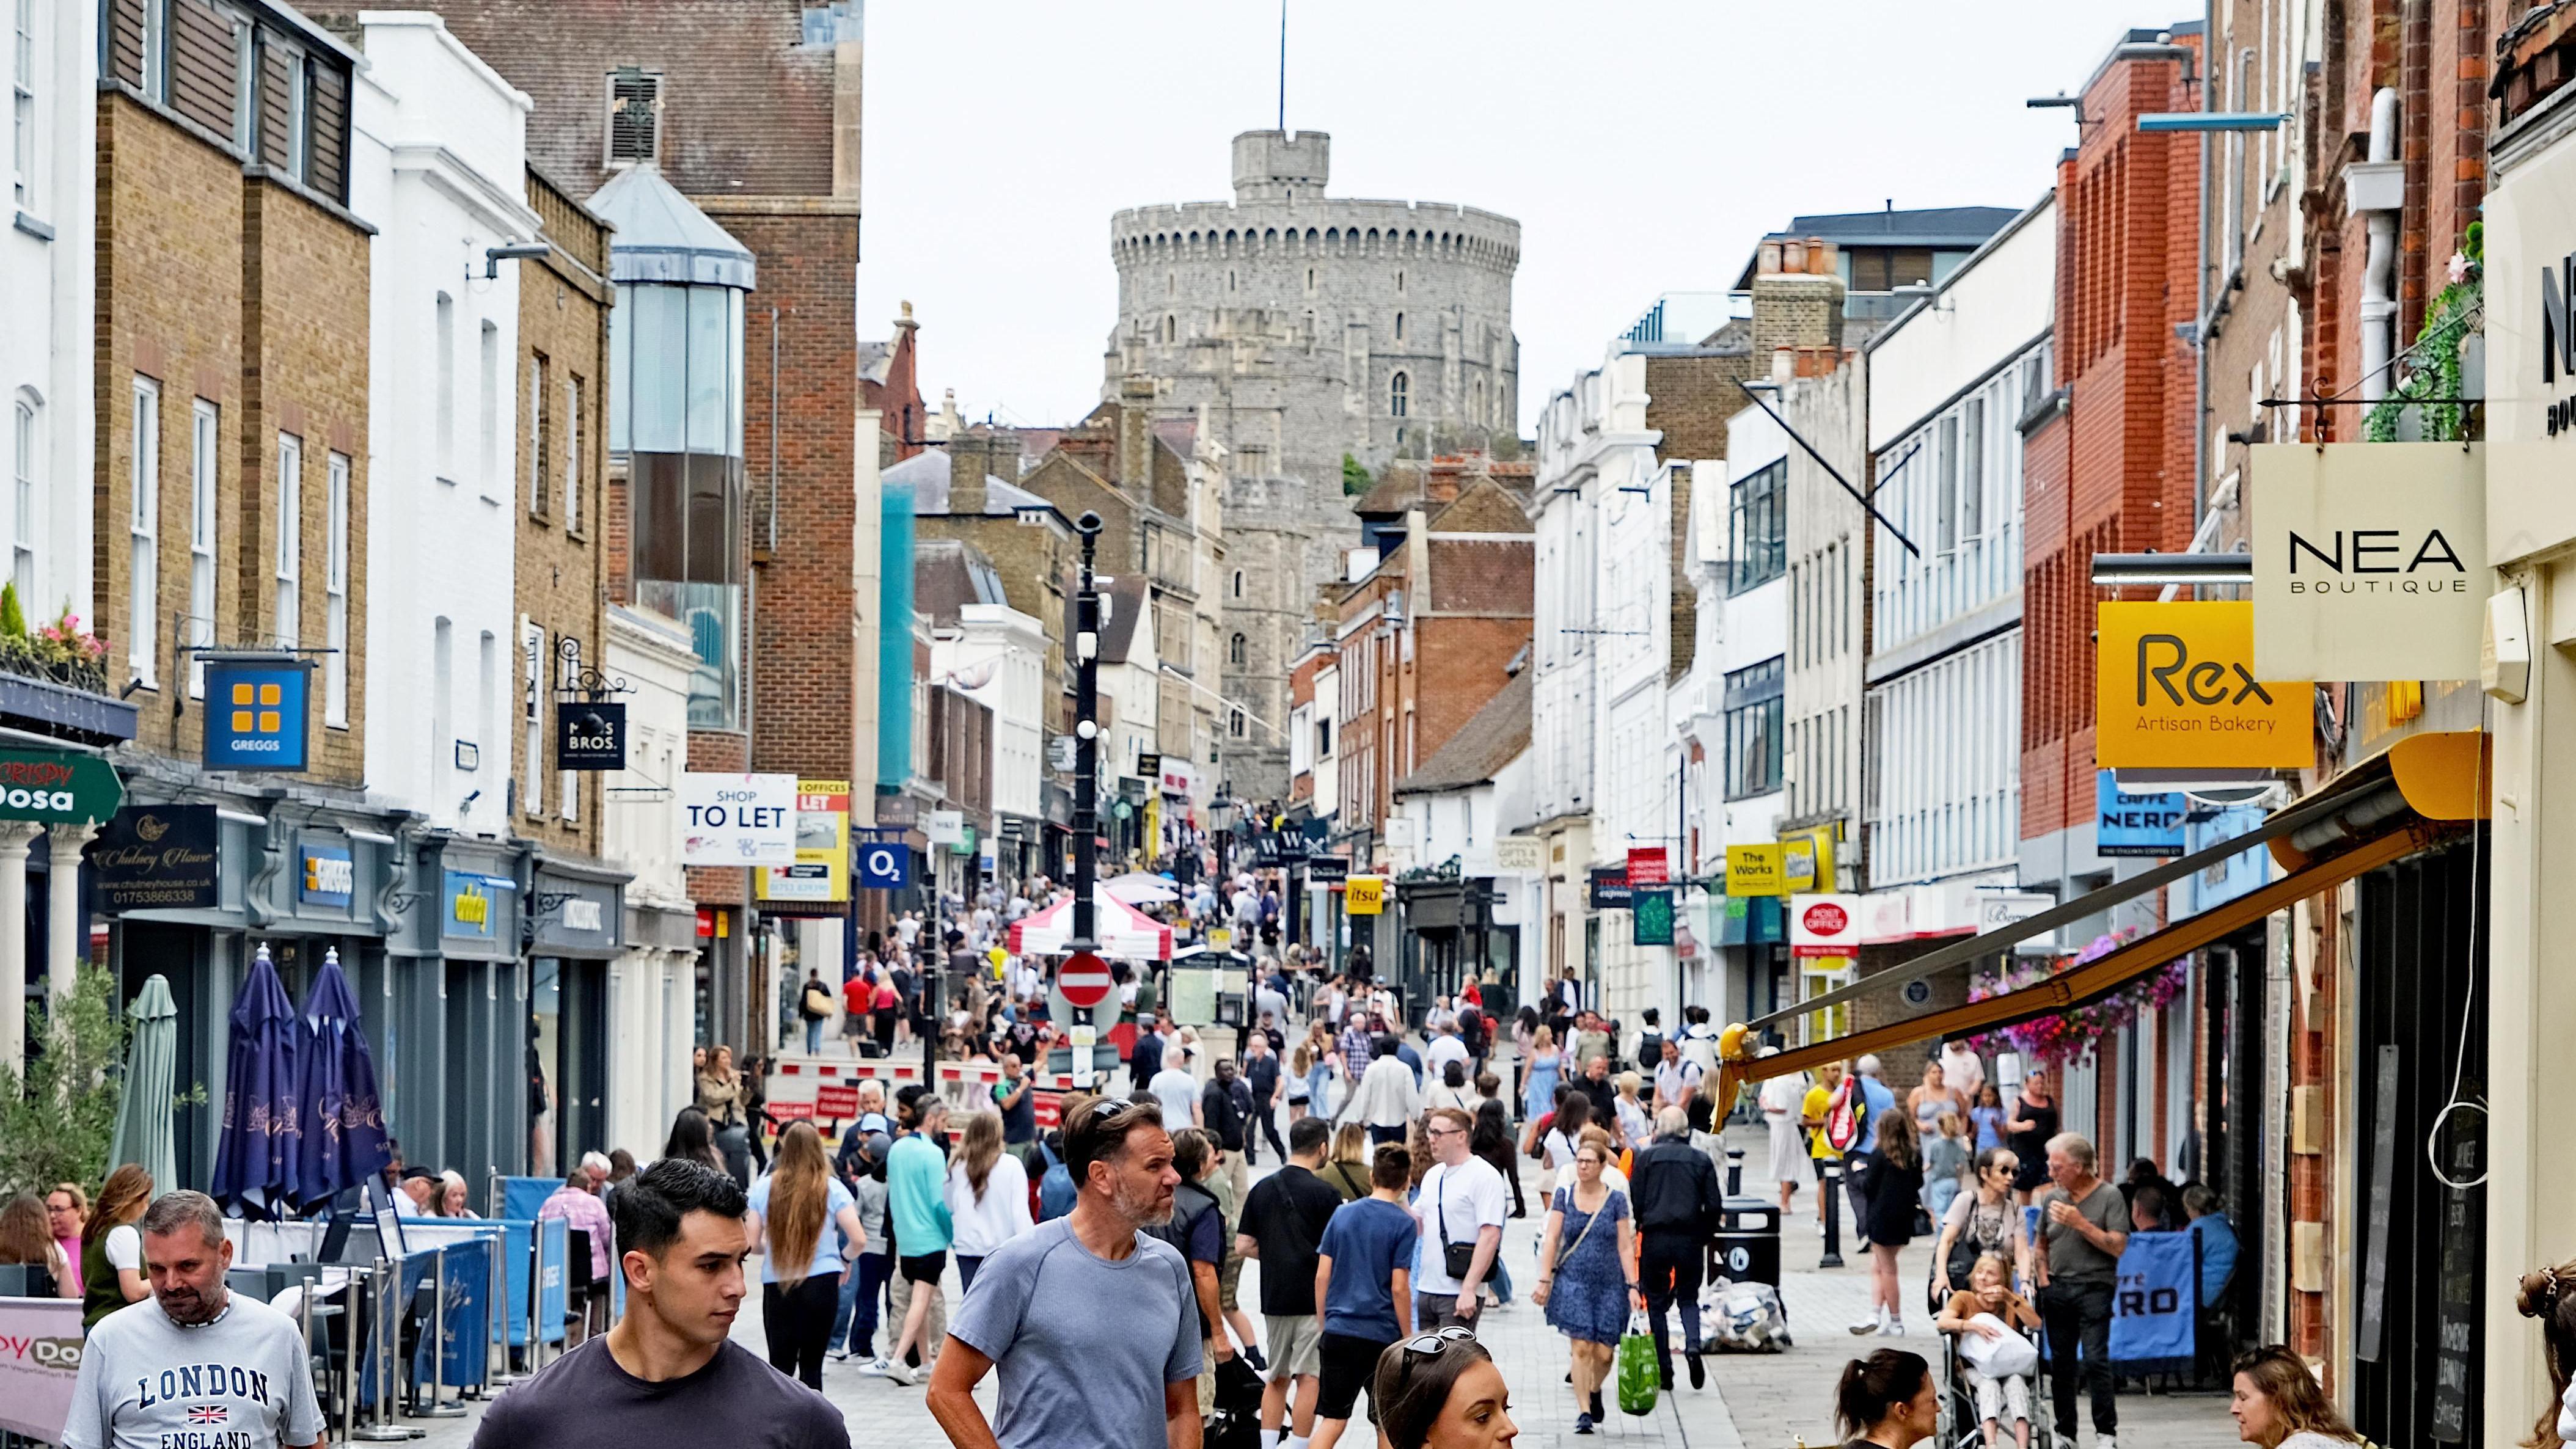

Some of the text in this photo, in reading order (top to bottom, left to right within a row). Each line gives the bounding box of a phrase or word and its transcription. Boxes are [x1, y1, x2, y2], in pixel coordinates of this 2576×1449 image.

[2290, 529, 2466, 574] NEA
[2291, 580, 2466, 594] BOUTIQUE
[2137, 634, 2274, 707] Rex
[569, 722, 614, 735] MS
[2136, 715, 2277, 735] Artisan Bakery
[231, 740, 280, 751] GREGGS
[569, 736, 618, 750] BROS.
[0, 762, 75, 787] CRISPY
[0, 784, 74, 811] osa
[717, 790, 758, 802] SHOP
[801, 795, 830, 810] LET
[687, 806, 786, 828] TO LET
[92, 845, 213, 875] Chutney House
[1743, 852, 1765, 863] The
[1735, 864, 1773, 875] Works
[1599, 878, 1627, 887] TESC
[1351, 888, 1379, 902] itsu
[1812, 908, 1840, 918] POST
[1805, 919, 1845, 929] OFFICE
[138, 1363, 269, 1411] LONDON
[161, 1431, 251, 1449] ENGLAND
